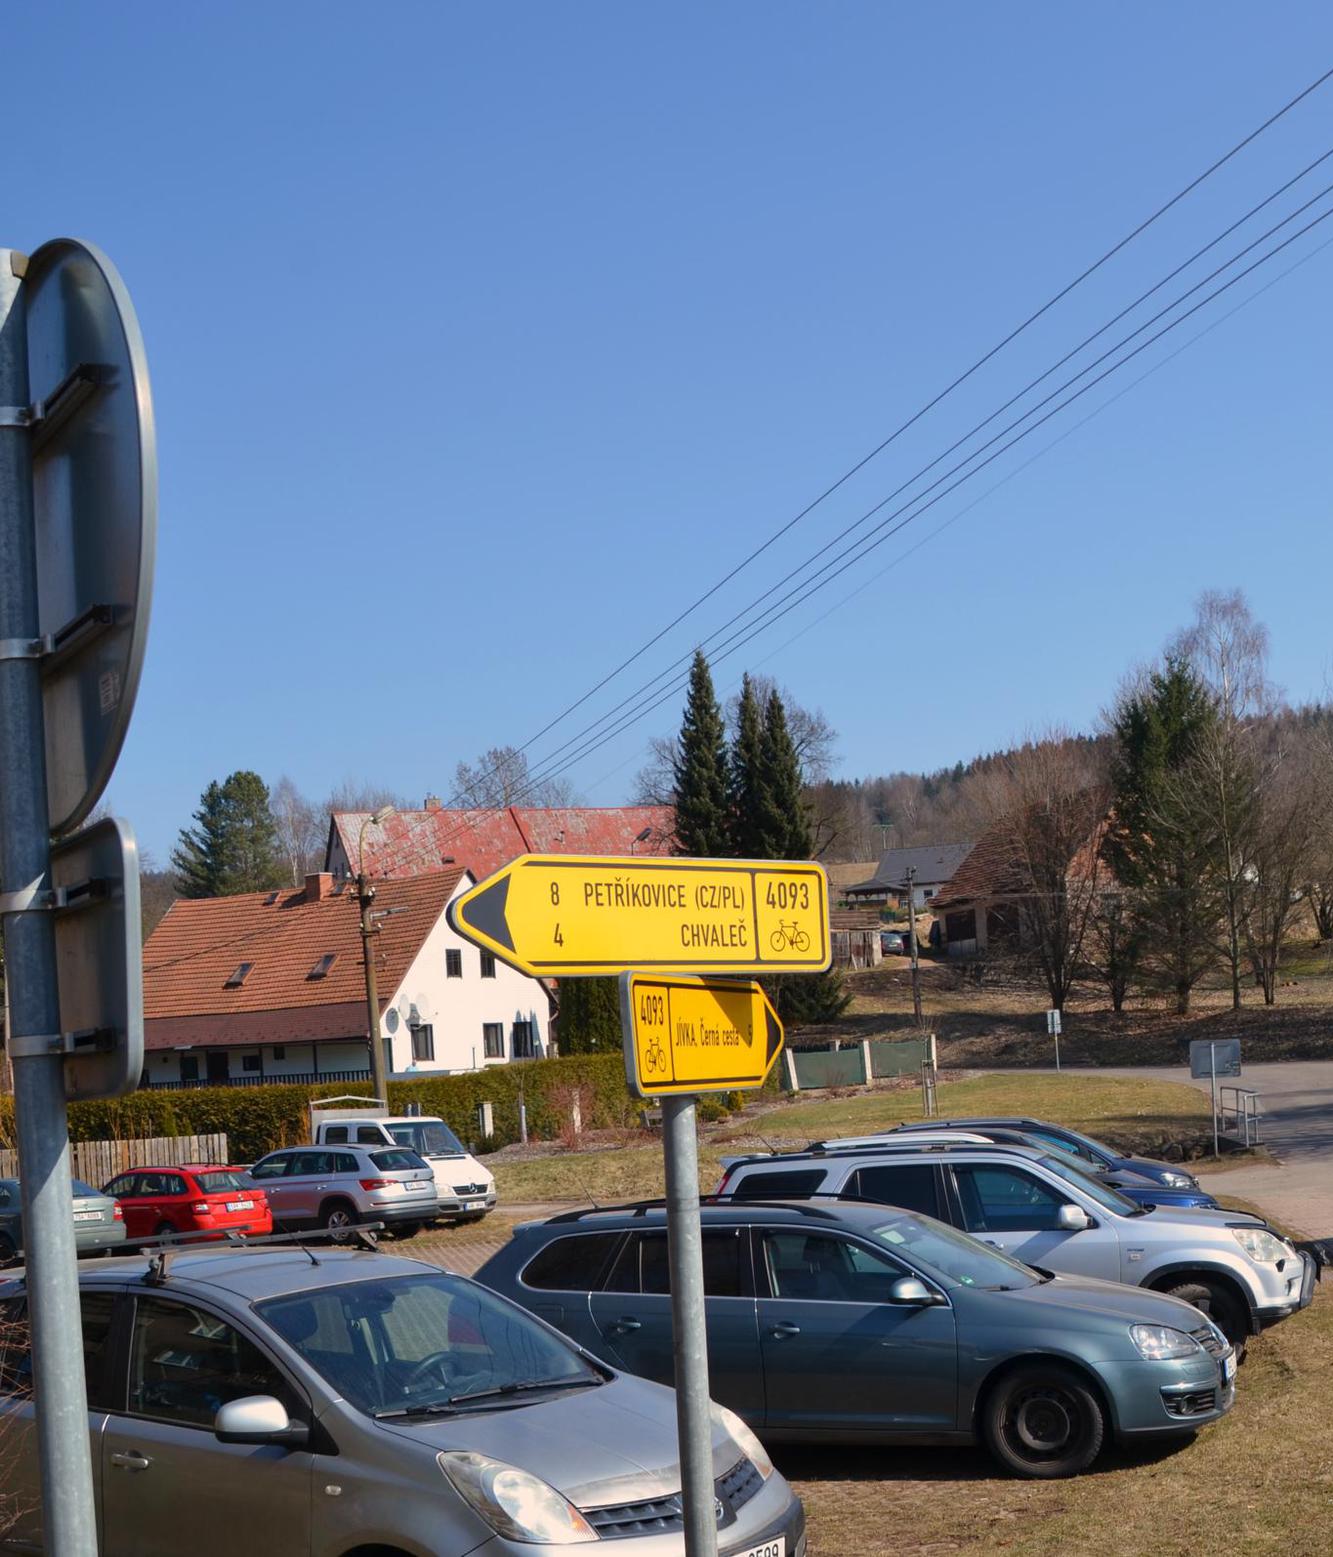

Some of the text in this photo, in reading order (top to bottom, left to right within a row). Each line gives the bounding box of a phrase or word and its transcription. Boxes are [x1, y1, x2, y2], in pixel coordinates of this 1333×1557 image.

[550, 876, 746, 911] 8 PETŘÍKOVICE (CZ/PL)
[766, 881, 810, 910] 4093
[553, 918, 748, 948] 4 CHVALEČ
[640, 994, 664, 1027] 4093
[700, 1016, 720, 1047] Černá
[723, 1027, 739, 1047] cesta
